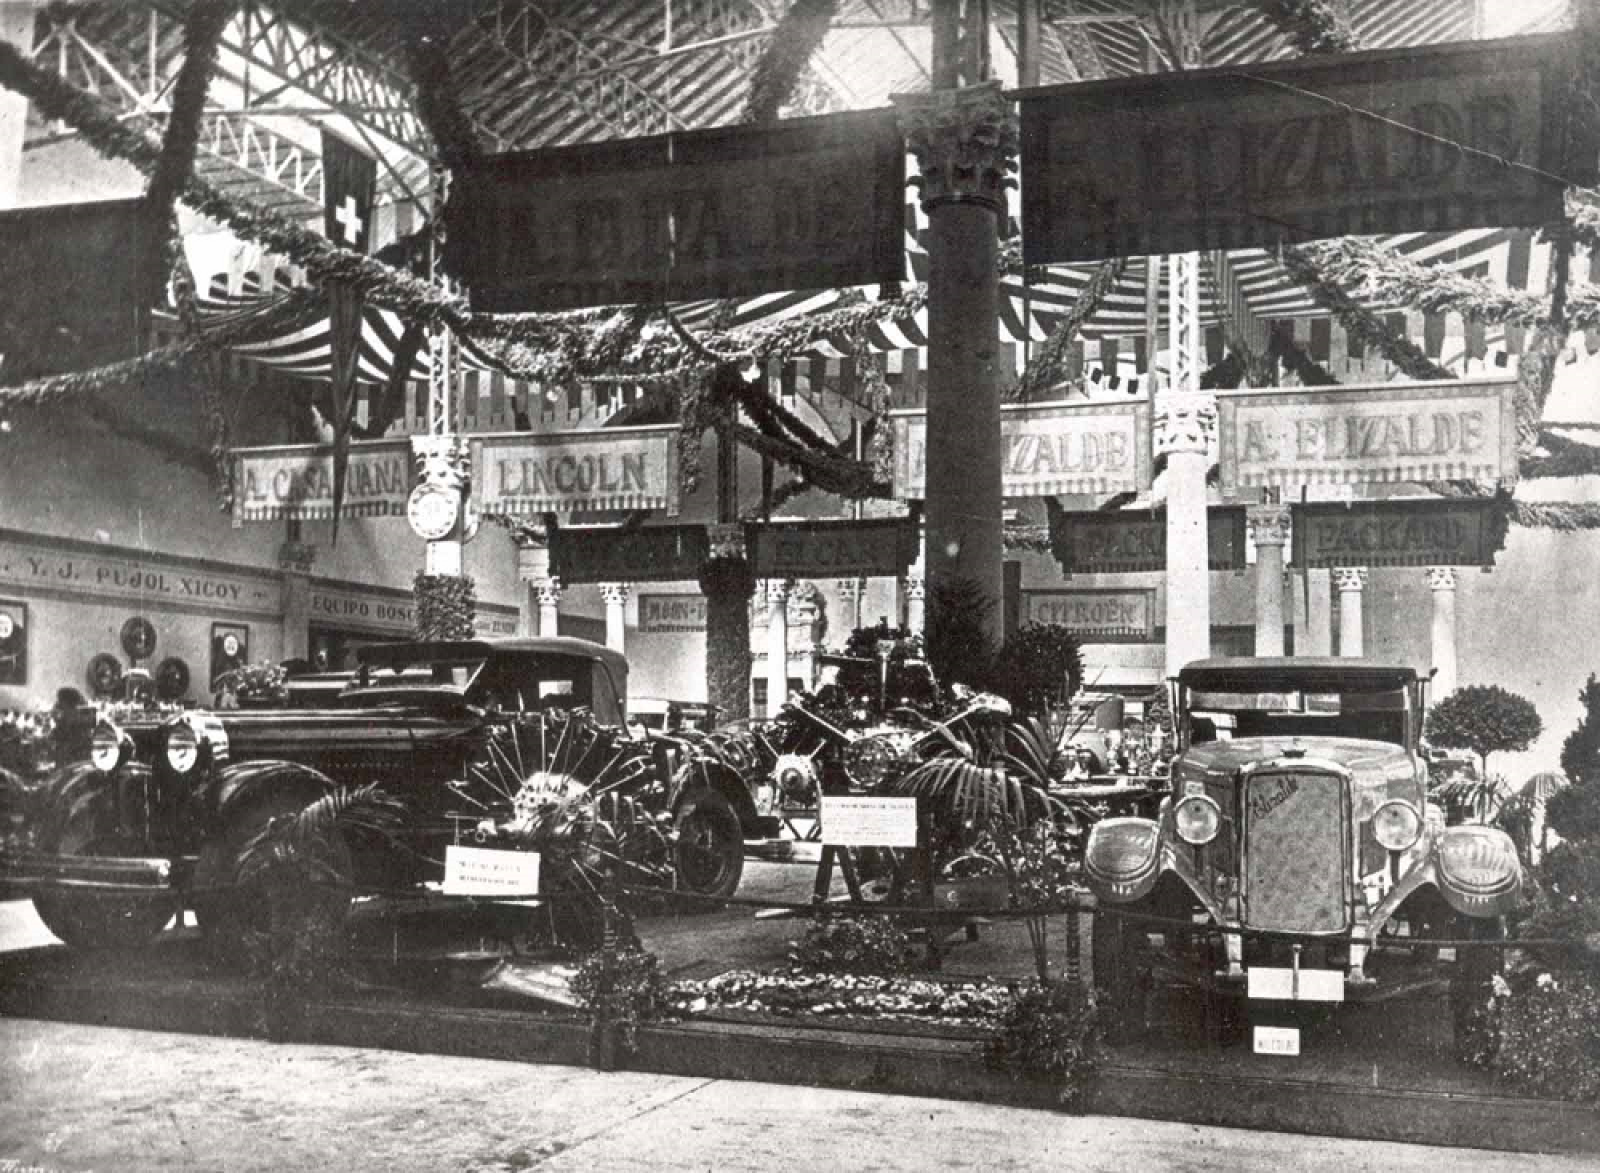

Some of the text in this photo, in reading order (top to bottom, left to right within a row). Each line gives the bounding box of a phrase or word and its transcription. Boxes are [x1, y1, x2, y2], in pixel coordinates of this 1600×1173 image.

[1000, 431, 1128, 474] IZALDE
[1295, 410, 1483, 461] ELIZALDE
[498, 453, 648, 496] LINCOLN
[96, 565, 171, 593] PUJOL
[179, 577, 242, 600] XICOY
[313, 596, 369, 617] EQUIPO
